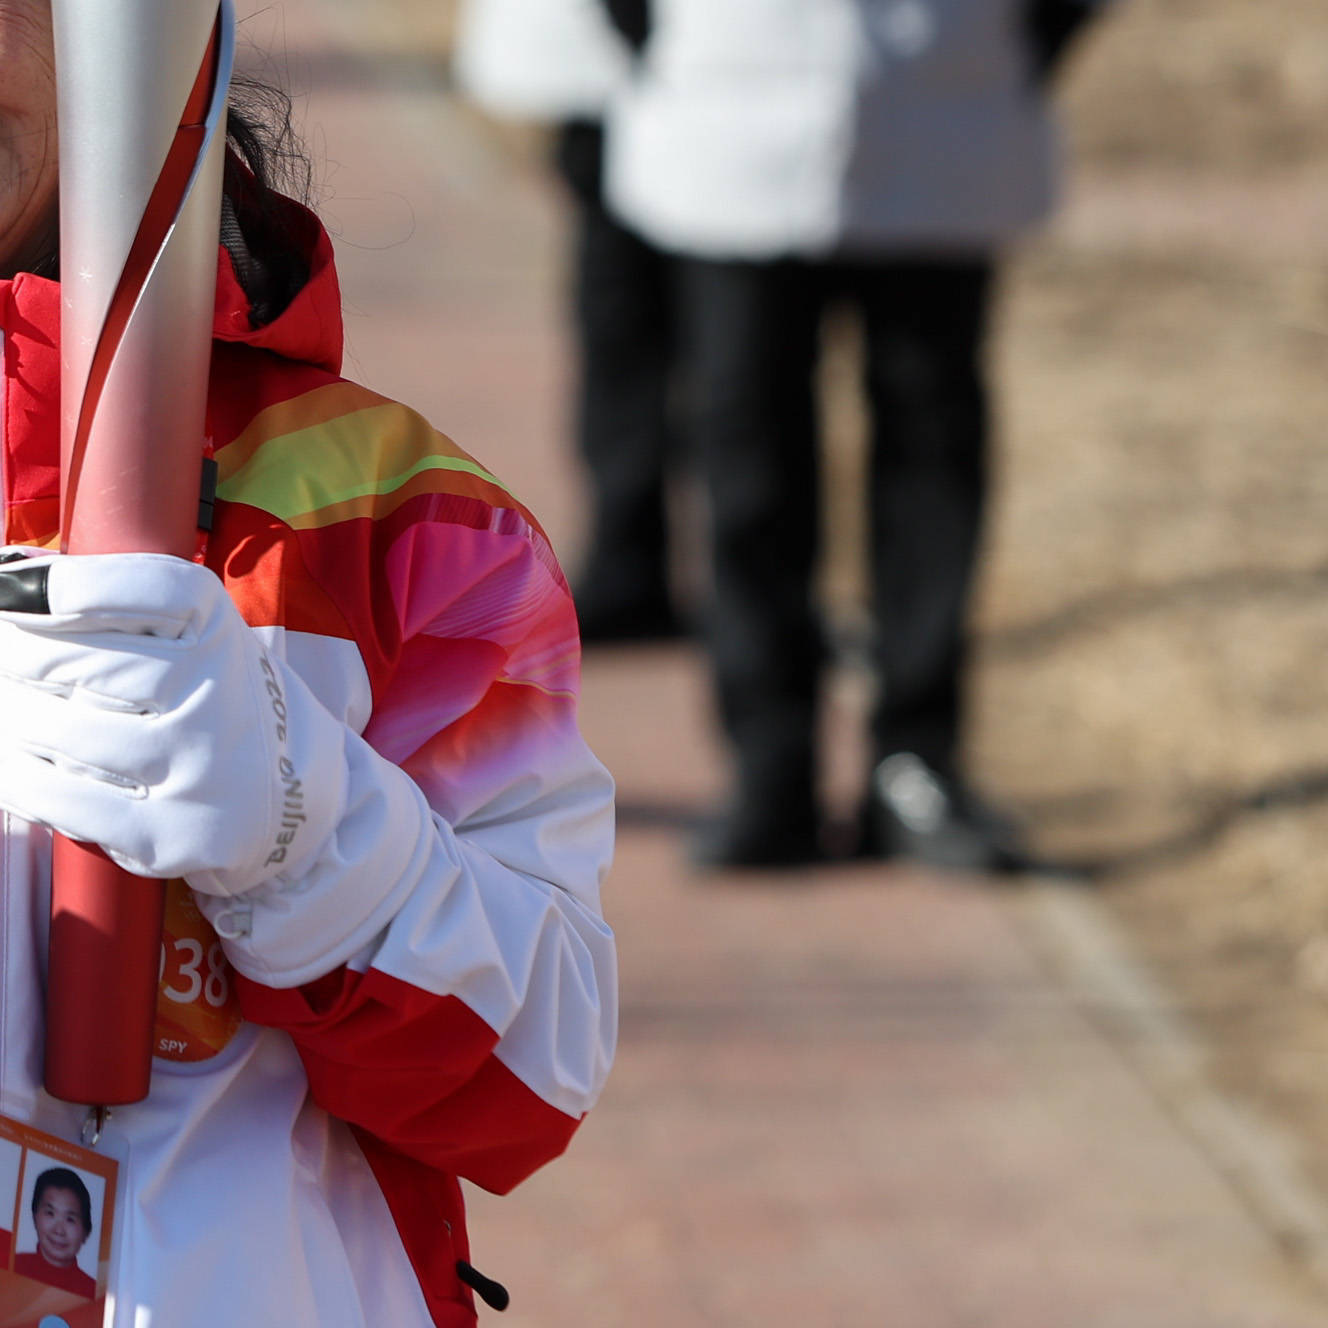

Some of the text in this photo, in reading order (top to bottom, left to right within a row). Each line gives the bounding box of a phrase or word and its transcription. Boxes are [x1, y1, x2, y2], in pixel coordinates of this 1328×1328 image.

[259, 648, 307, 868] BEIJING 2022
[158, 938, 229, 1008] 38
[158, 1038, 188, 1055] SPY
